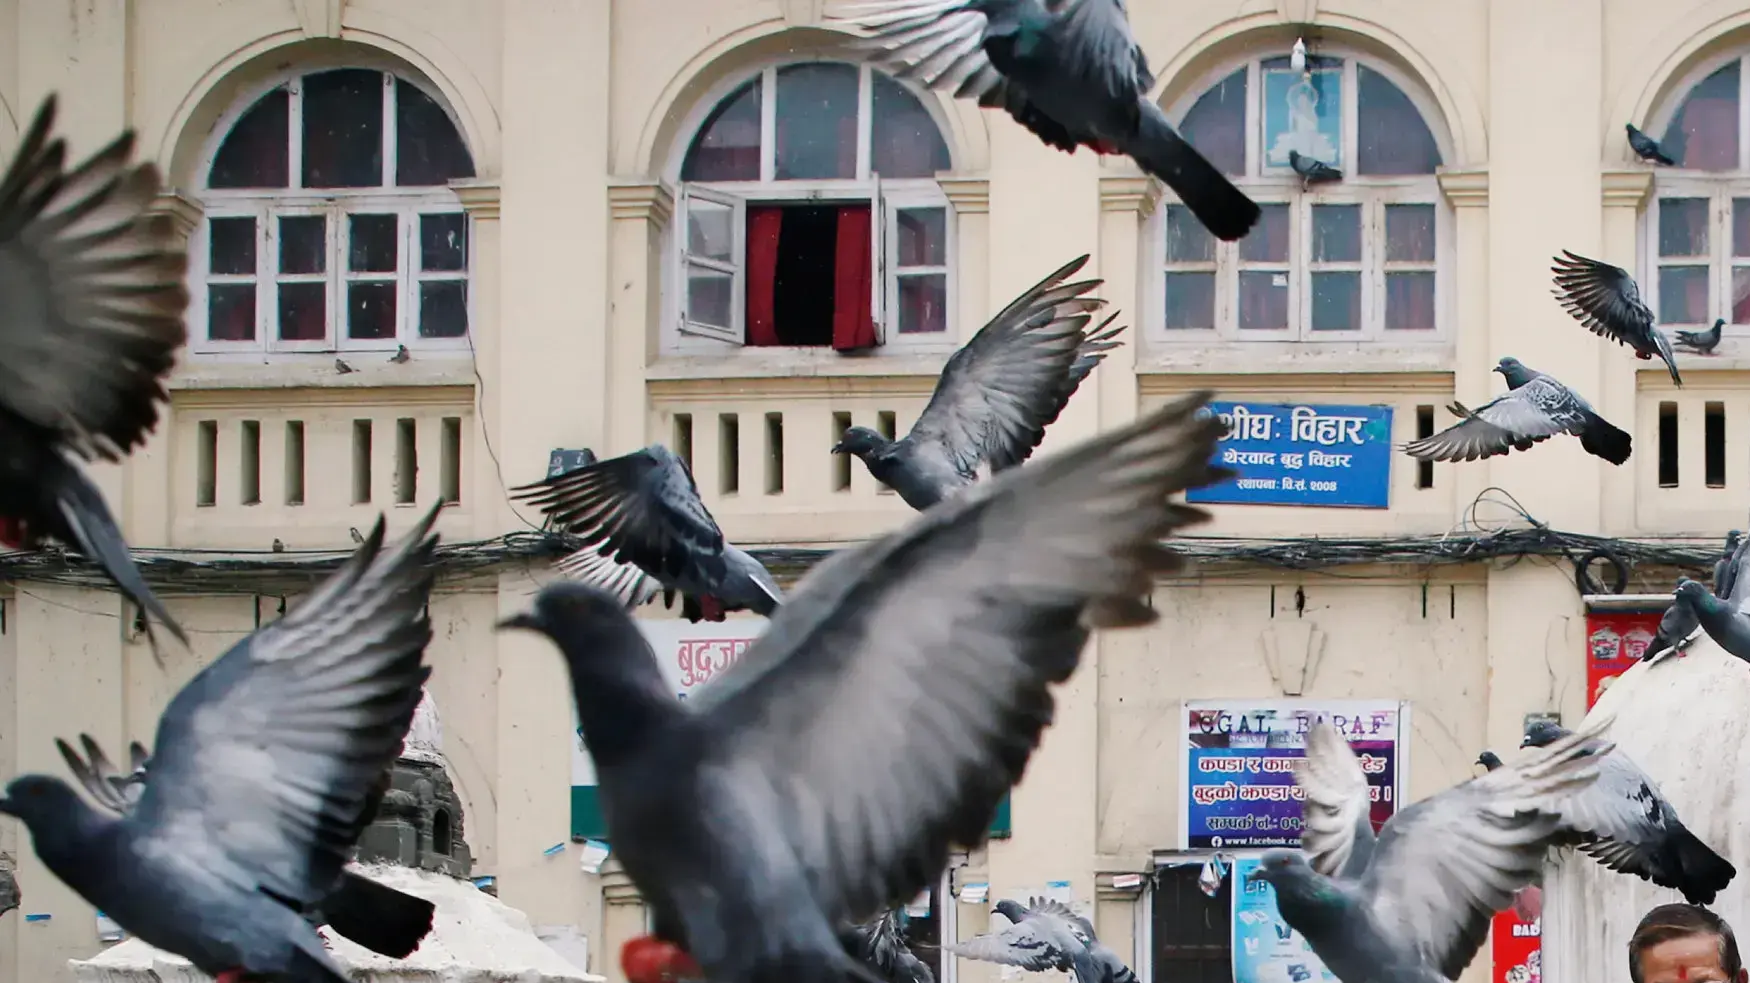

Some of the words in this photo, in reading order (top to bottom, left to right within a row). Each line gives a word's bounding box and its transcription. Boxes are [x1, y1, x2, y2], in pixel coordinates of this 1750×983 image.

[1290, 406, 1369, 445] विहार
[1223, 448, 1276, 466] थेरवाद
[1280, 452, 1304, 470] बुद्ध
[1308, 450, 1353, 467] विहार
[1199, 756, 1243, 773] कपडा
[1247, 757, 1261, 773] र
[1240, 784, 1290, 802] झण्डा
[1512, 923, 1541, 937] BAD
